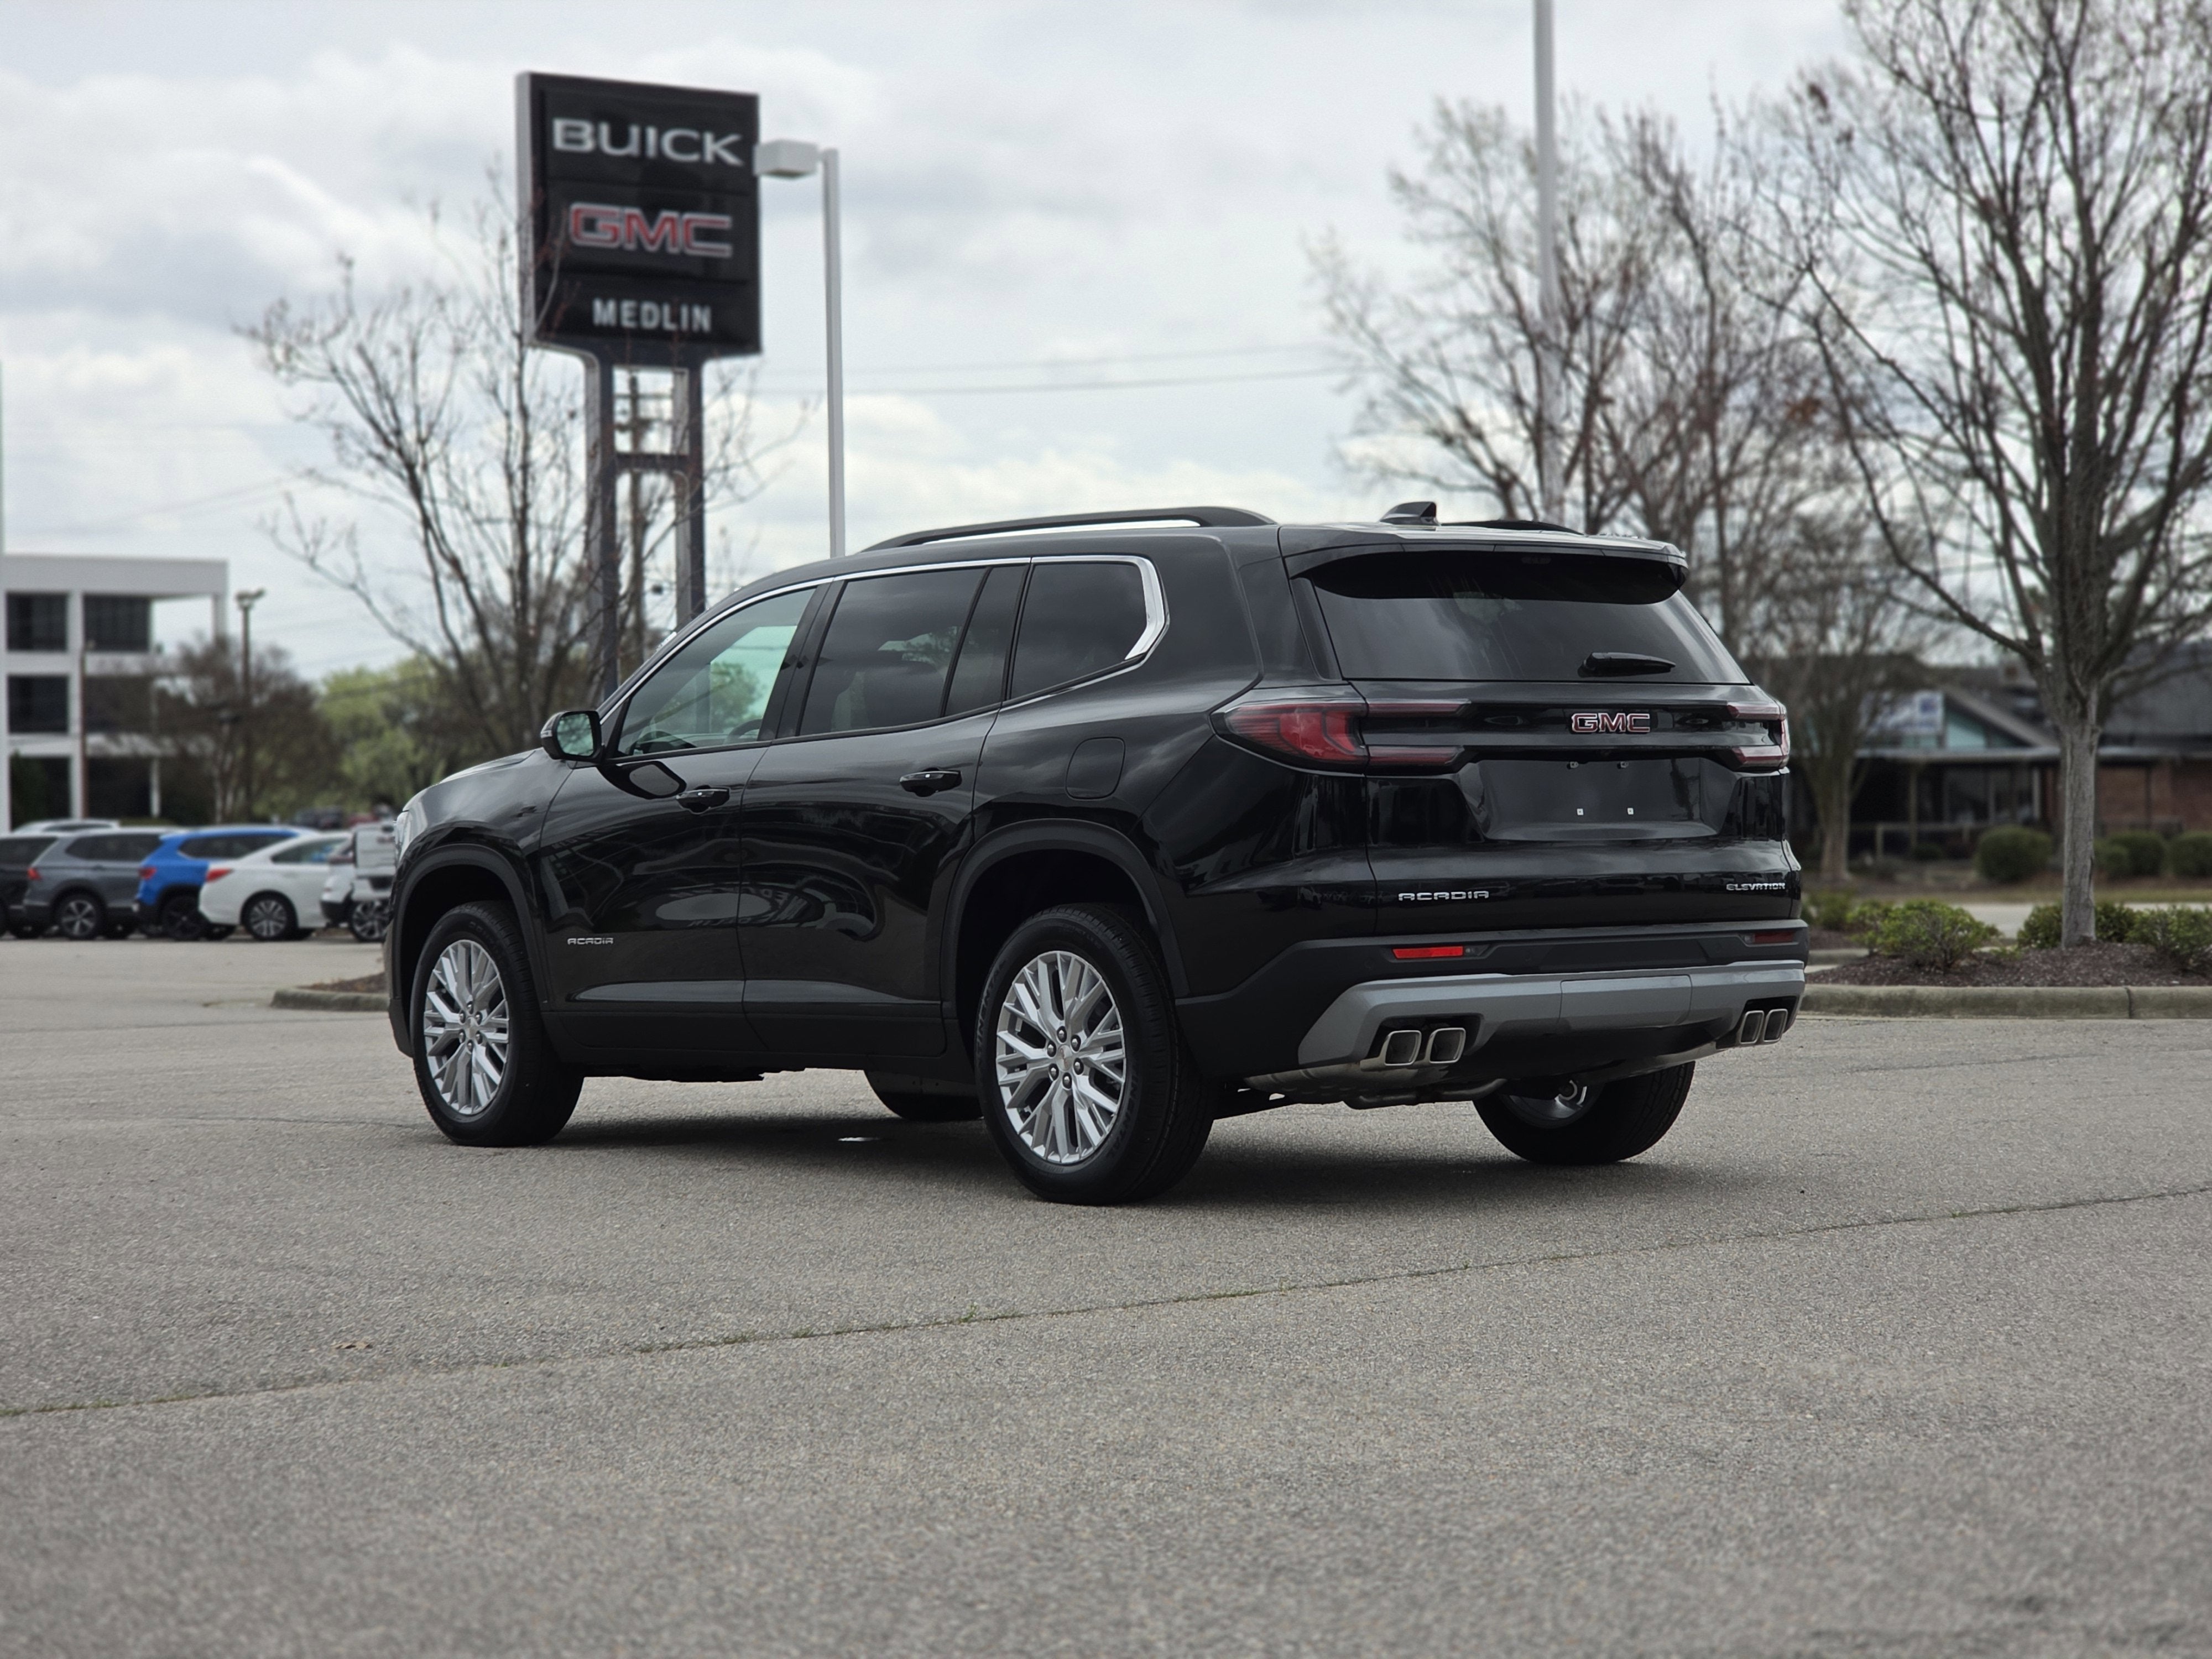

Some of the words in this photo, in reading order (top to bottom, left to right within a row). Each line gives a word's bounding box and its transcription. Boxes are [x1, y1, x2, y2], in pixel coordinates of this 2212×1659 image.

[553, 118, 744, 166] BUICK
[569, 201, 733, 258] GMC
[592, 297, 712, 332] MEDLIN
[1571, 712, 1650, 733] GMC
[1398, 890, 1489, 901] ACADIA
[1726, 883, 1786, 891] ELEVATION
